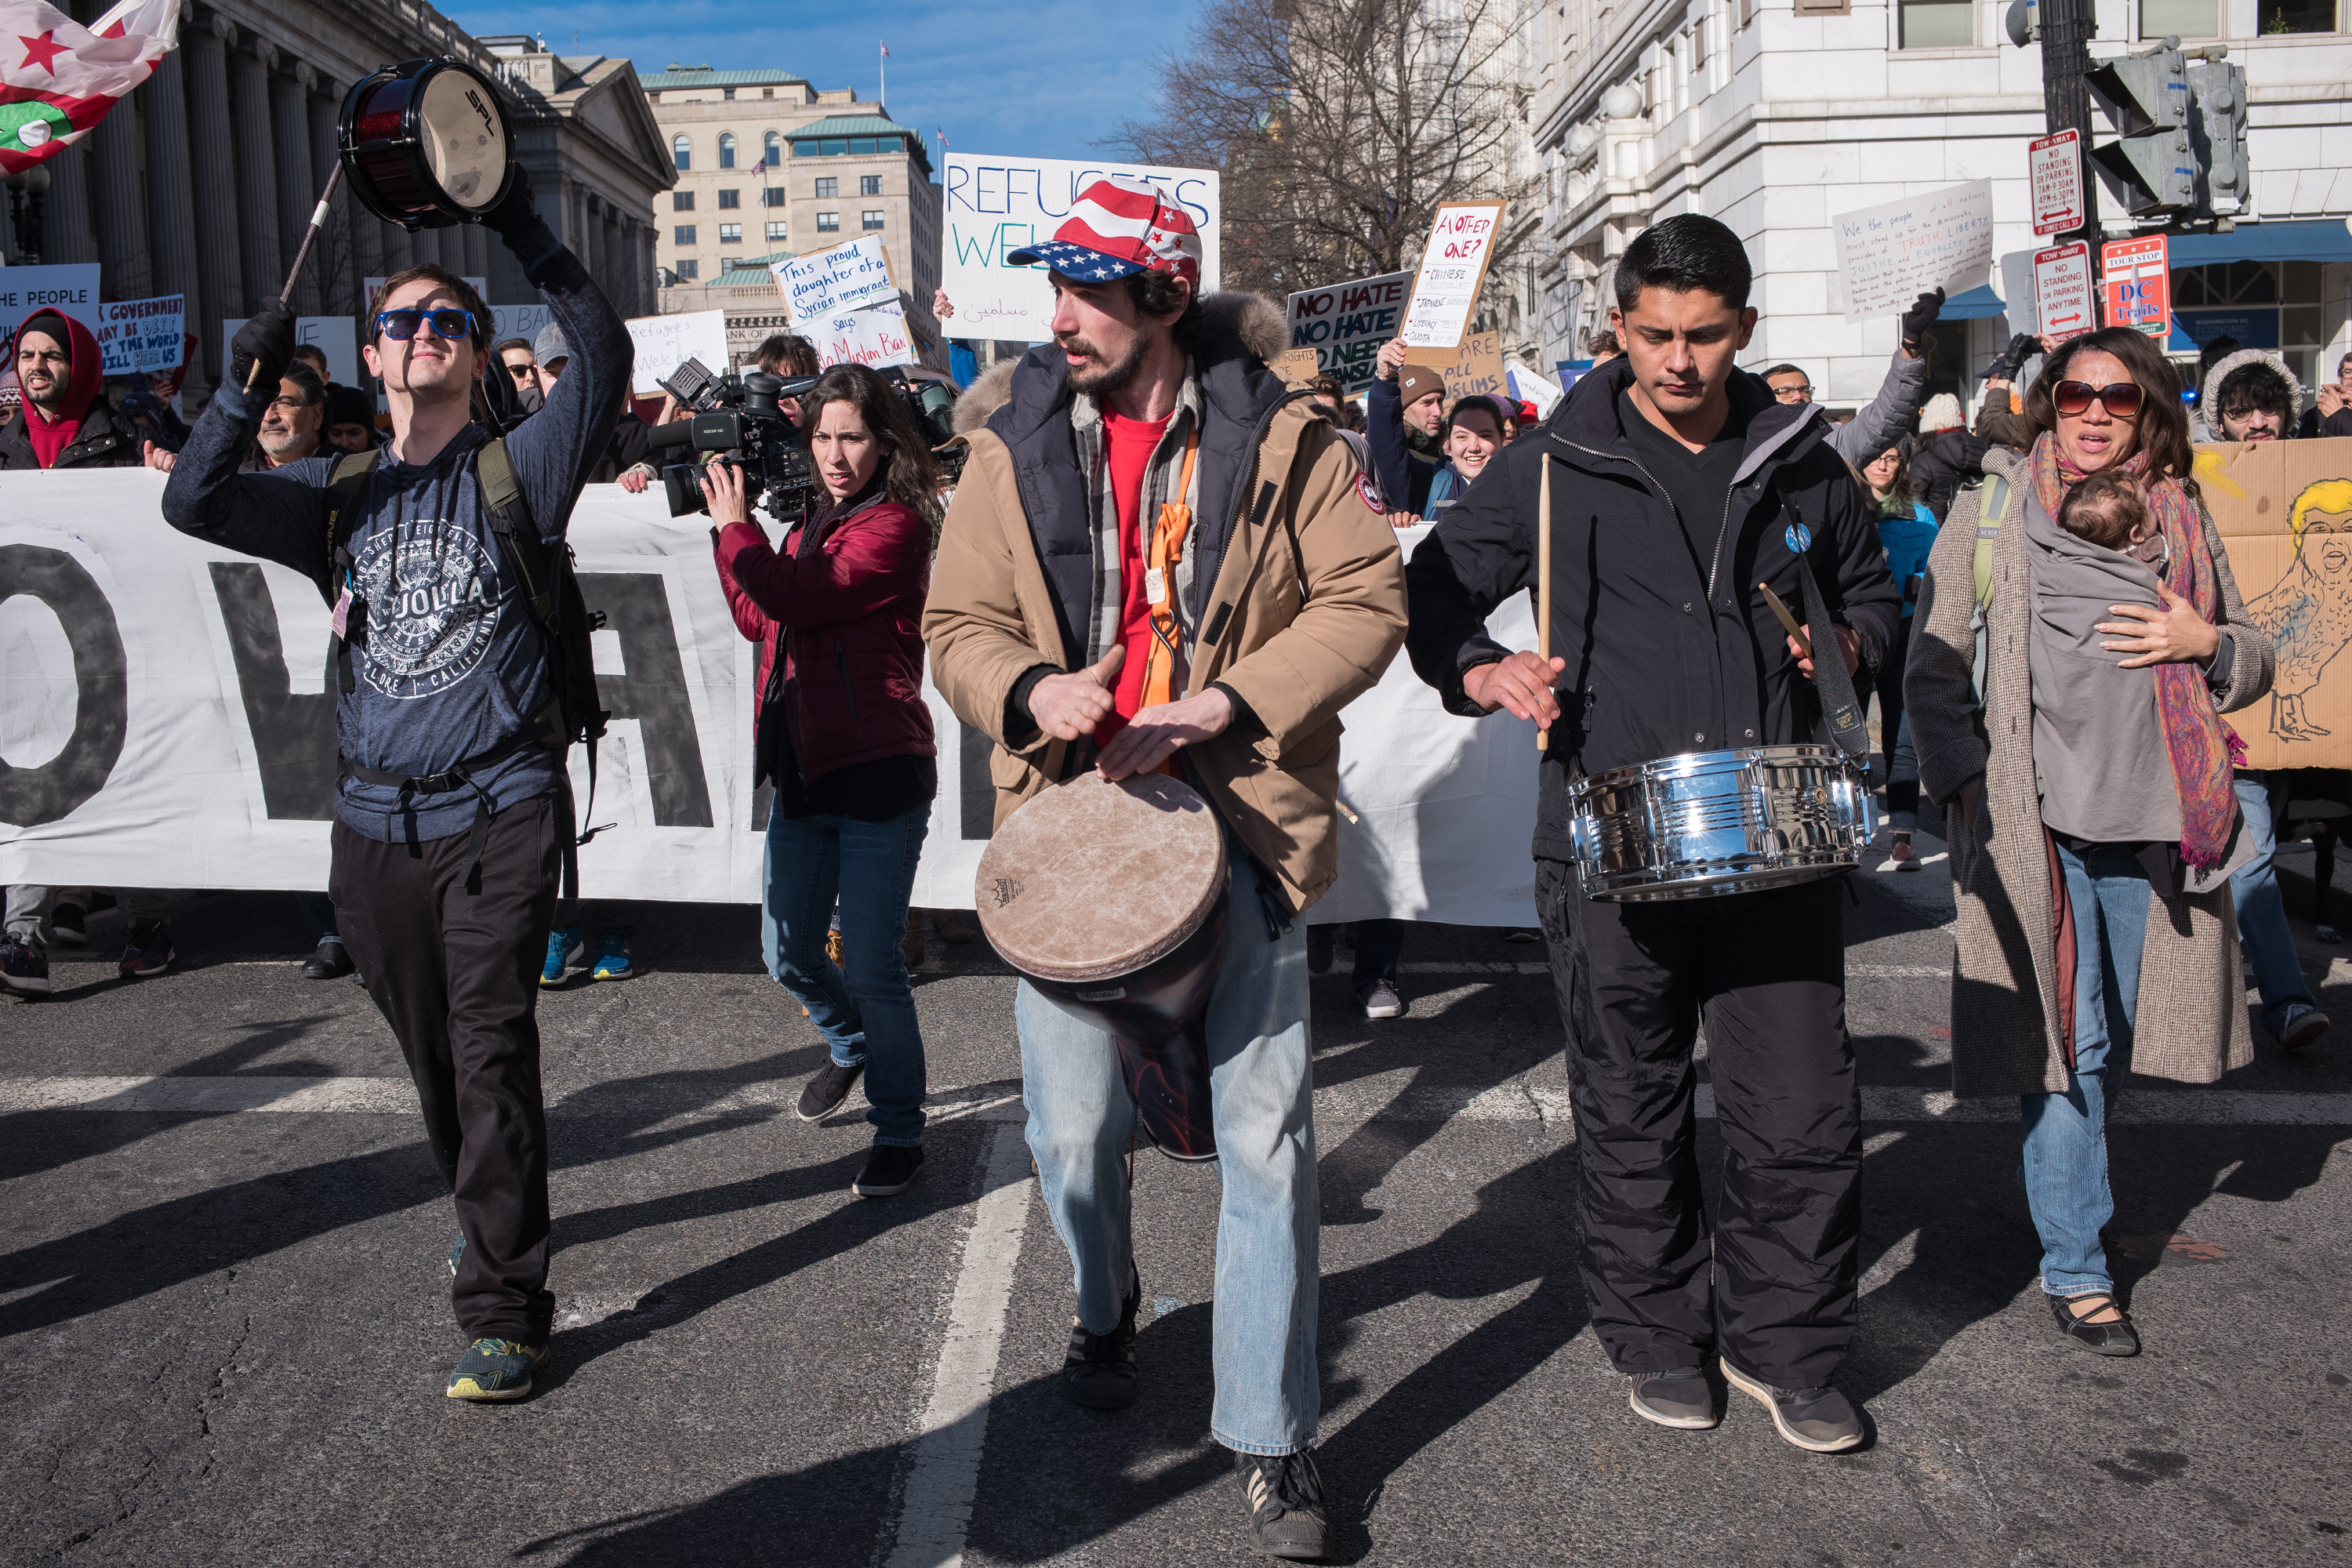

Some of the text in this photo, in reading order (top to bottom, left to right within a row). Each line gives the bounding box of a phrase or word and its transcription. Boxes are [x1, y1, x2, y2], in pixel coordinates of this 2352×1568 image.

[465, 89, 494, 137] SPL
[2036, 133, 2071, 149] TOW AWAY
[2049, 149, 2059, 159] NO
[2038, 156, 2071, 173] STANDING
[2037, 166, 2074, 184] OR PARKING
[2038, 178, 2074, 194] 7AM-9:30AM
[947, 165, 1210, 229] REFUS
[2038, 188, 2074, 204] 4PM-6:30PM
[1843, 192, 1985, 237] We the people of all nations
[1436, 212, 1490, 239] ANOTHER
[1846, 240, 1866, 252] must
[1871, 234, 1888, 245] stand
[1937, 210, 1971, 225] democratic
[2043, 223, 2059, 234] TOWED
[2060, 220, 2070, 230] CALL
[1444, 239, 1482, 259] ONE?
[1848, 252, 1875, 265] principles
[1898, 230, 1943, 253] TRUTH,
[1948, 216, 1988, 238] LIBERTY,
[1849, 258, 1895, 276] JUSTICE,
[1899, 255, 1910, 263] and
[1917, 239, 1964, 260] EQUALITY,
[1980, 230, 1991, 240] fight
[2041, 247, 2079, 261] TOW AWAY
[2109, 252, 2160, 267] TOUR STOP
[779, 244, 862, 282] This proud
[2055, 263, 2067, 273] NO
[793, 257, 886, 298] daughter of a
[1430, 269, 1466, 280] CHINESE
[1860, 274, 1879, 284] ensure
[1911, 262, 1925, 270] words
[1896, 276, 1913, 285] policies
[2043, 272, 2082, 288] STANDING
[1425, 281, 1457, 291] EXCLUSION
[1853, 297, 1867, 306] those
[1950, 268, 1962, 280] profit
[2053, 284, 2084, 298] PARKING
[2118, 280, 2153, 303] DC
[27, 289, 87, 305] PEOPLE
[794, 275, 890, 319] Syrian immigrant
[1296, 281, 1403, 319] NO HATE
[1418, 297, 1446, 308] JAPANESE
[1878, 299, 1900, 309] wealthy
[2047, 297, 2082, 311] ANYTIME
[110, 299, 183, 321] GOVERNMENT
[1416, 310, 1431, 318] CAMPS
[2115, 303, 2158, 320] Trails
[125, 322, 137, 337] BE
[143, 317, 176, 337] DEAF
[630, 321, 690, 339] Refugees
[833, 317, 856, 333] says
[1292, 307, 1398, 347] NO HATE
[1413, 319, 1438, 330] LITERACY
[2196, 325, 2249, 334] ECONOMIC
[118, 336, 143, 354] THE
[147, 332, 180, 350] WORLD
[751, 329, 766, 339] OF
[1408, 331, 1430, 343] QUOTA
[1445, 335, 1458, 345] 1924
[2053, 333, 2067, 342] OWED
[833, 338, 881, 365] Muslim
[1284, 350, 1314, 362] RIGHTS
[1461, 337, 1494, 359] ARE
[133, 350, 160, 368] HEAR
[162, 347, 176, 364] US
[635, 350, 706, 372] Welcome
[1444, 362, 1472, 380] ALL
[1445, 374, 1498, 400] USLIMS
[395, 575, 498, 618] JOLLA
[430, 612, 495, 687] CALIFORNIA
[1000, 880, 1008, 902] REMO
